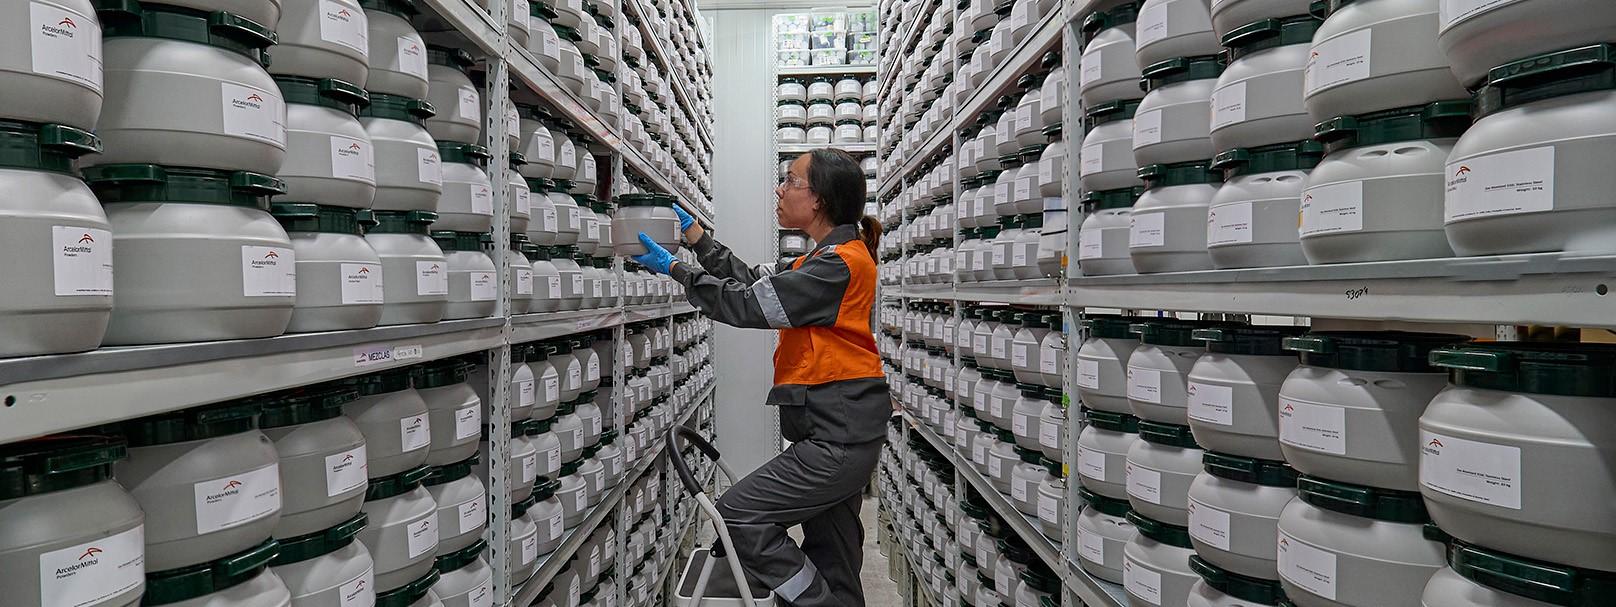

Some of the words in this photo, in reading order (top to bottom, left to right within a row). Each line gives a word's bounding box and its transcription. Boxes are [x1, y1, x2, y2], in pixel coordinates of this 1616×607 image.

[41, 24, 74, 38] ArcelorMittal
[368, 350, 390, 361] MEZCLAS
[205, 488, 239, 501] ArcelorMittal
[55, 558, 98, 575] ArcelorMittal
[56, 571, 76, 579] Powders
